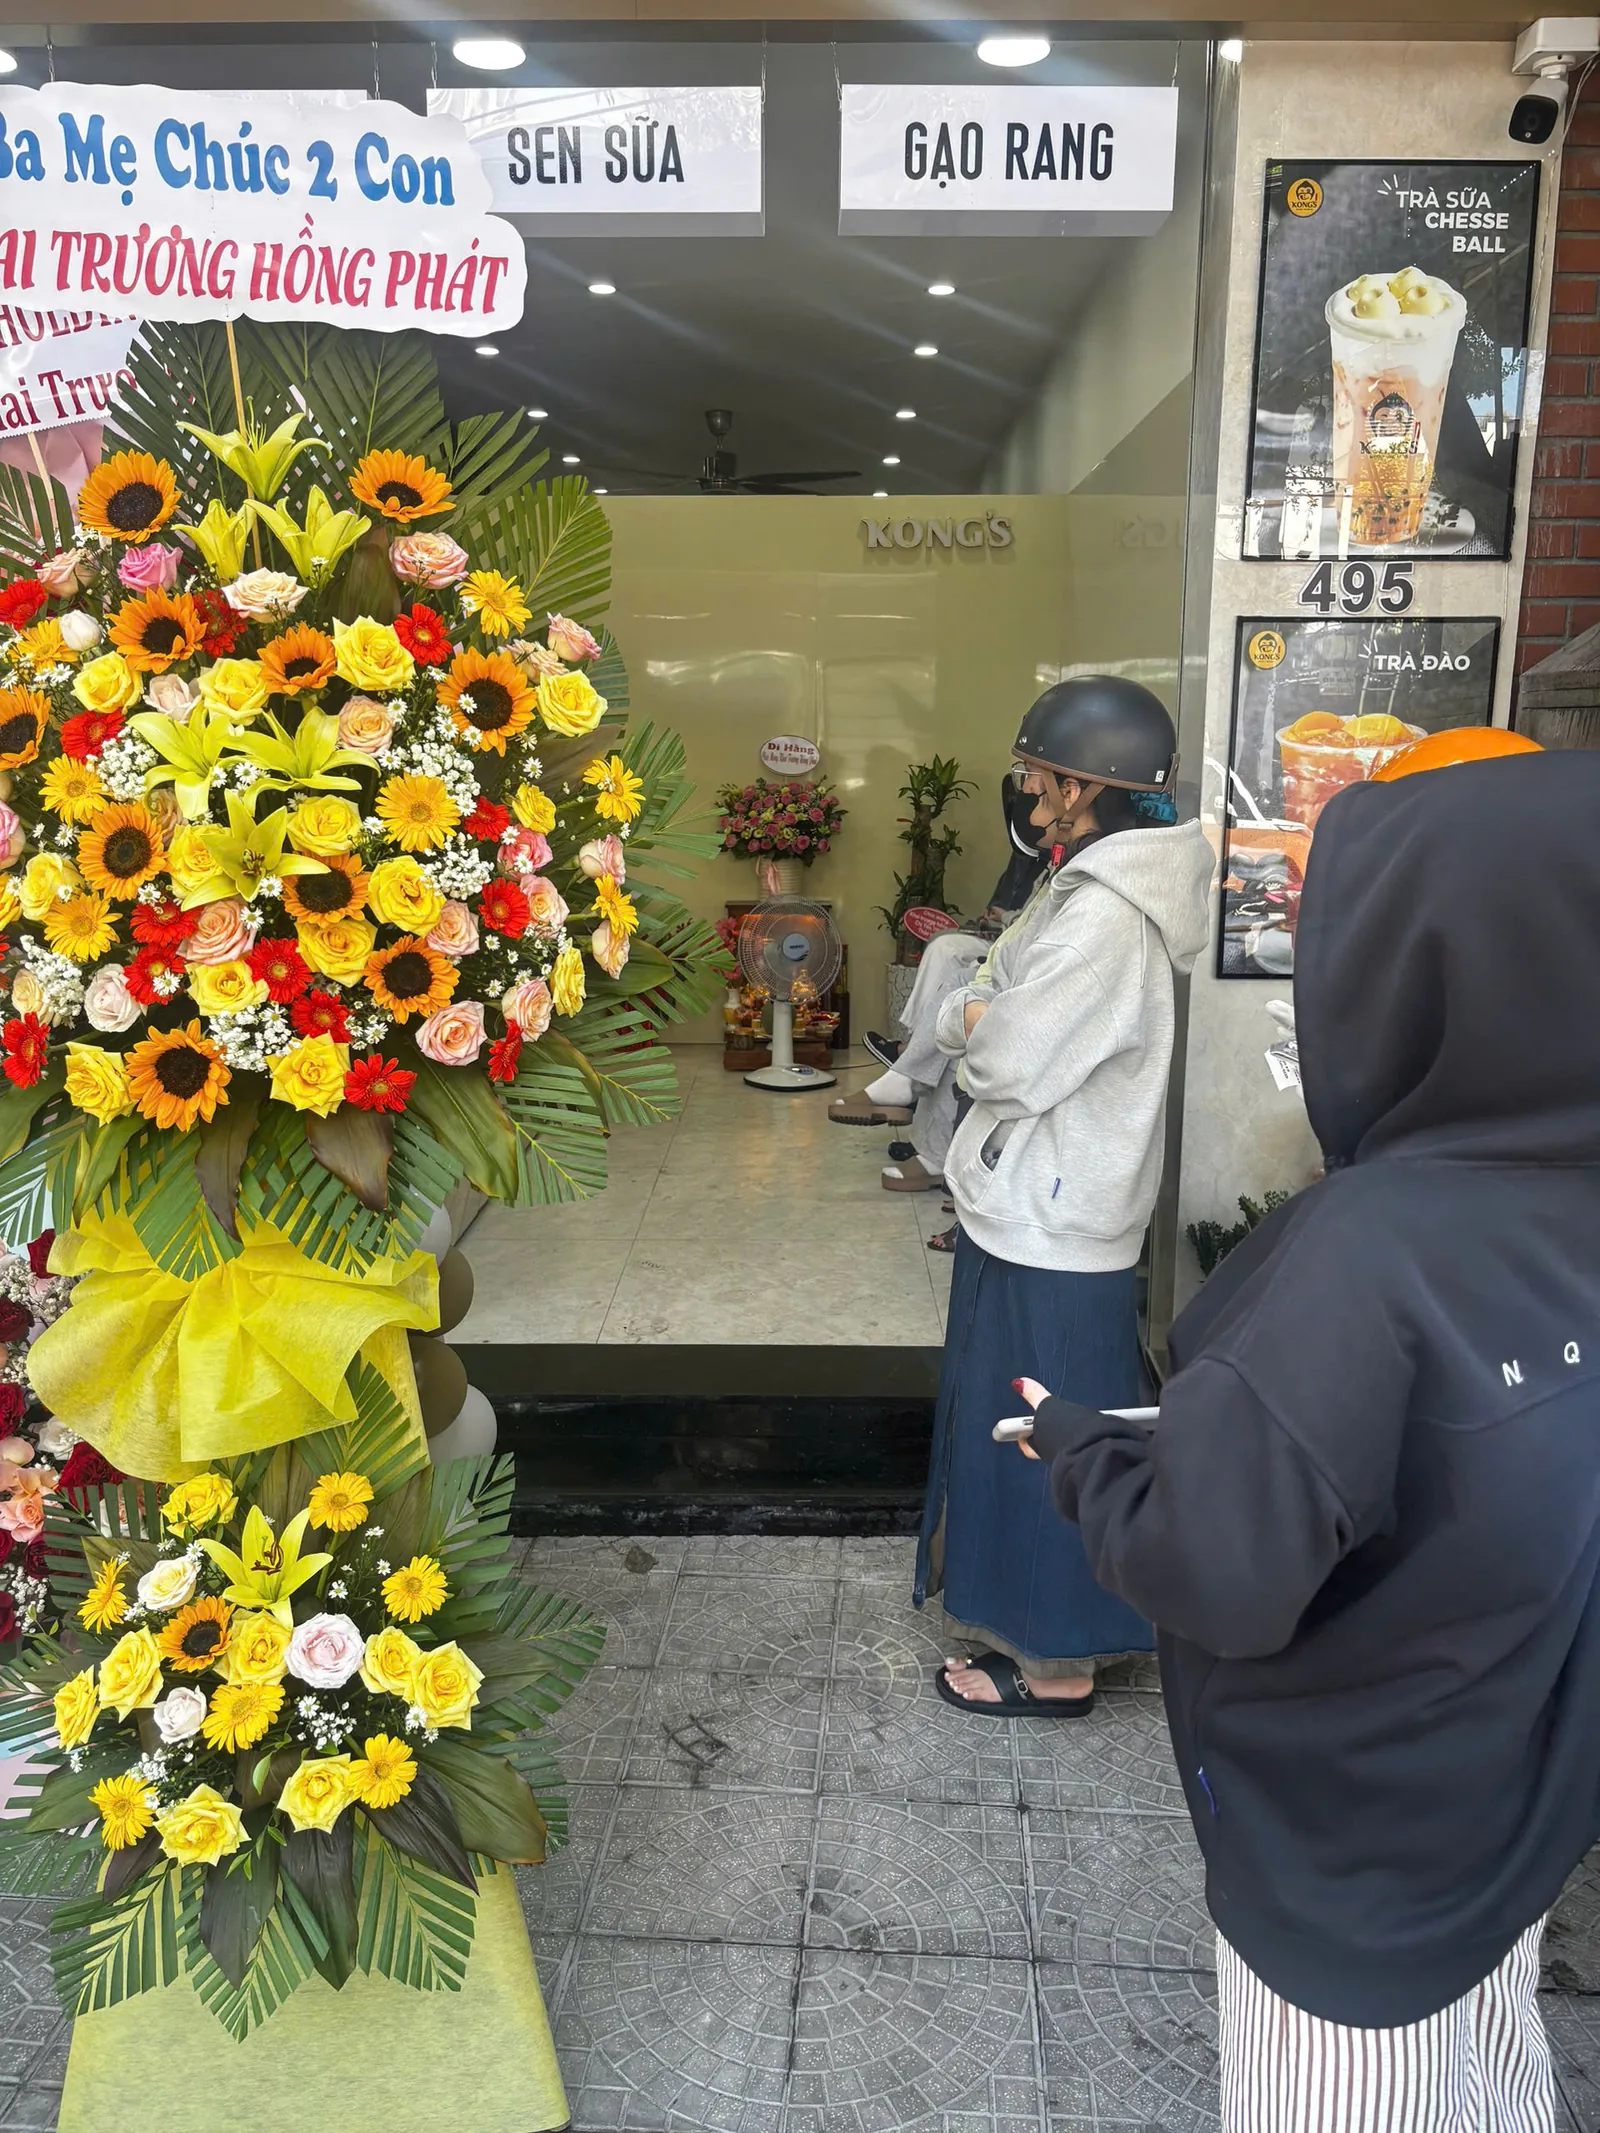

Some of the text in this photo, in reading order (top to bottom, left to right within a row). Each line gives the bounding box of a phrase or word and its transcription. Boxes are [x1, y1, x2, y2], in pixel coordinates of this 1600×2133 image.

[58, 112, 138, 206] Mẹ
[154, 118, 291, 195] Chúc
[306, 140, 338, 202] 2
[354, 132, 455, 206] Con
[507, 116, 685, 185] SEN SỮA
[904, 121, 1114, 189] GẠO RANG
[1396, 186, 1492, 209] TRÀ SỮA
[1425, 211, 1510, 229] CHESSE
[249, 212, 375, 307] HỒNG
[385, 237, 509, 314] PHÁT
[1452, 236, 1506, 253] BALL
[0, 376, 42, 431] ai
[860, 510, 1012, 549] KONG'S
[1299, 561, 1415, 615] 495
[1374, 650, 1471, 671] TRÀ ĐÀO
[1502, 1341, 1581, 1387] N Q
